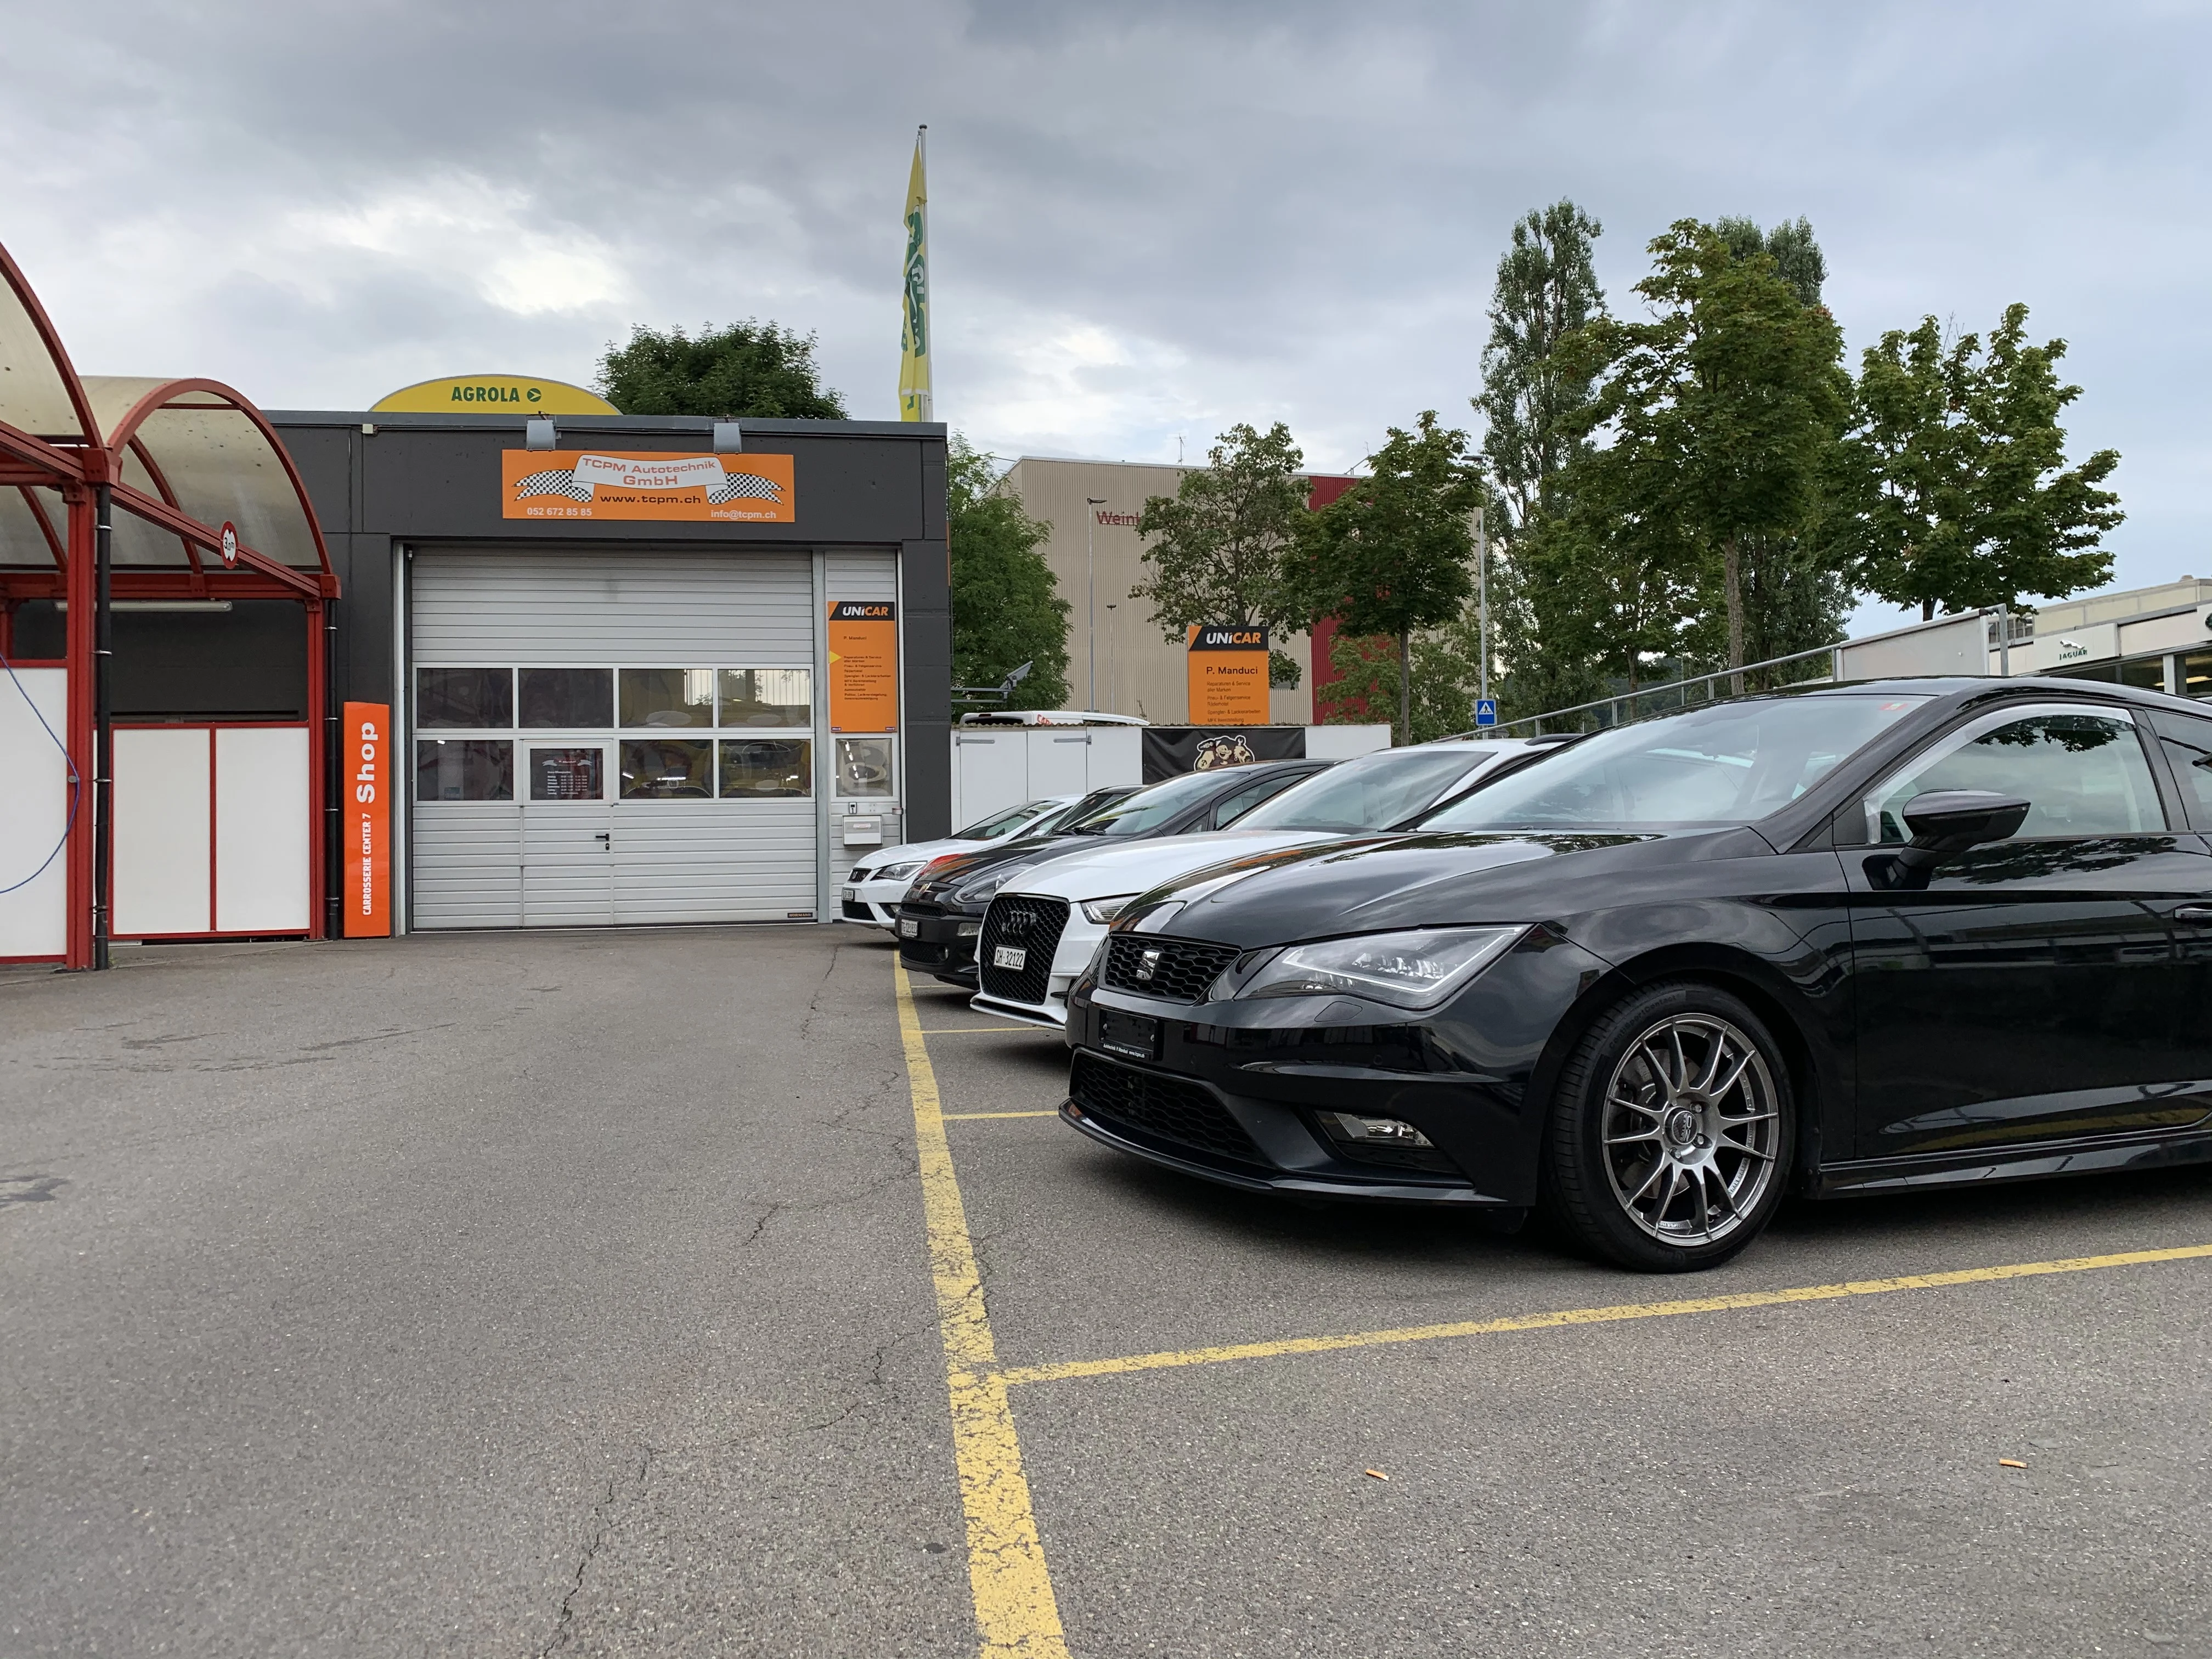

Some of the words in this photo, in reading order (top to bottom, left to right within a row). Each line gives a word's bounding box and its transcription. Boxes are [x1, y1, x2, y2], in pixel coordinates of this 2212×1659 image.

[451, 386, 520, 402] AGROLA
[583, 458, 627, 472] TCPM
[631, 460, 716, 474] Autotechnik
[623, 475, 678, 486] GmbH
[600, 495, 701, 505] www.tcpm.ch
[527, 507, 544, 516] 052
[546, 508, 564, 516] 672
[566, 508, 578, 516] 85
[580, 508, 592, 516] 85
[710, 510, 776, 520] info@tcpm.ch
[2059, 649, 2087, 660] JAGUAR
[1218, 666, 1258, 675] Manduci
[356, 721, 379, 804] Shop
[362, 820, 372, 855] CENTER
[362, 856, 372, 916] CARROSSERIE
